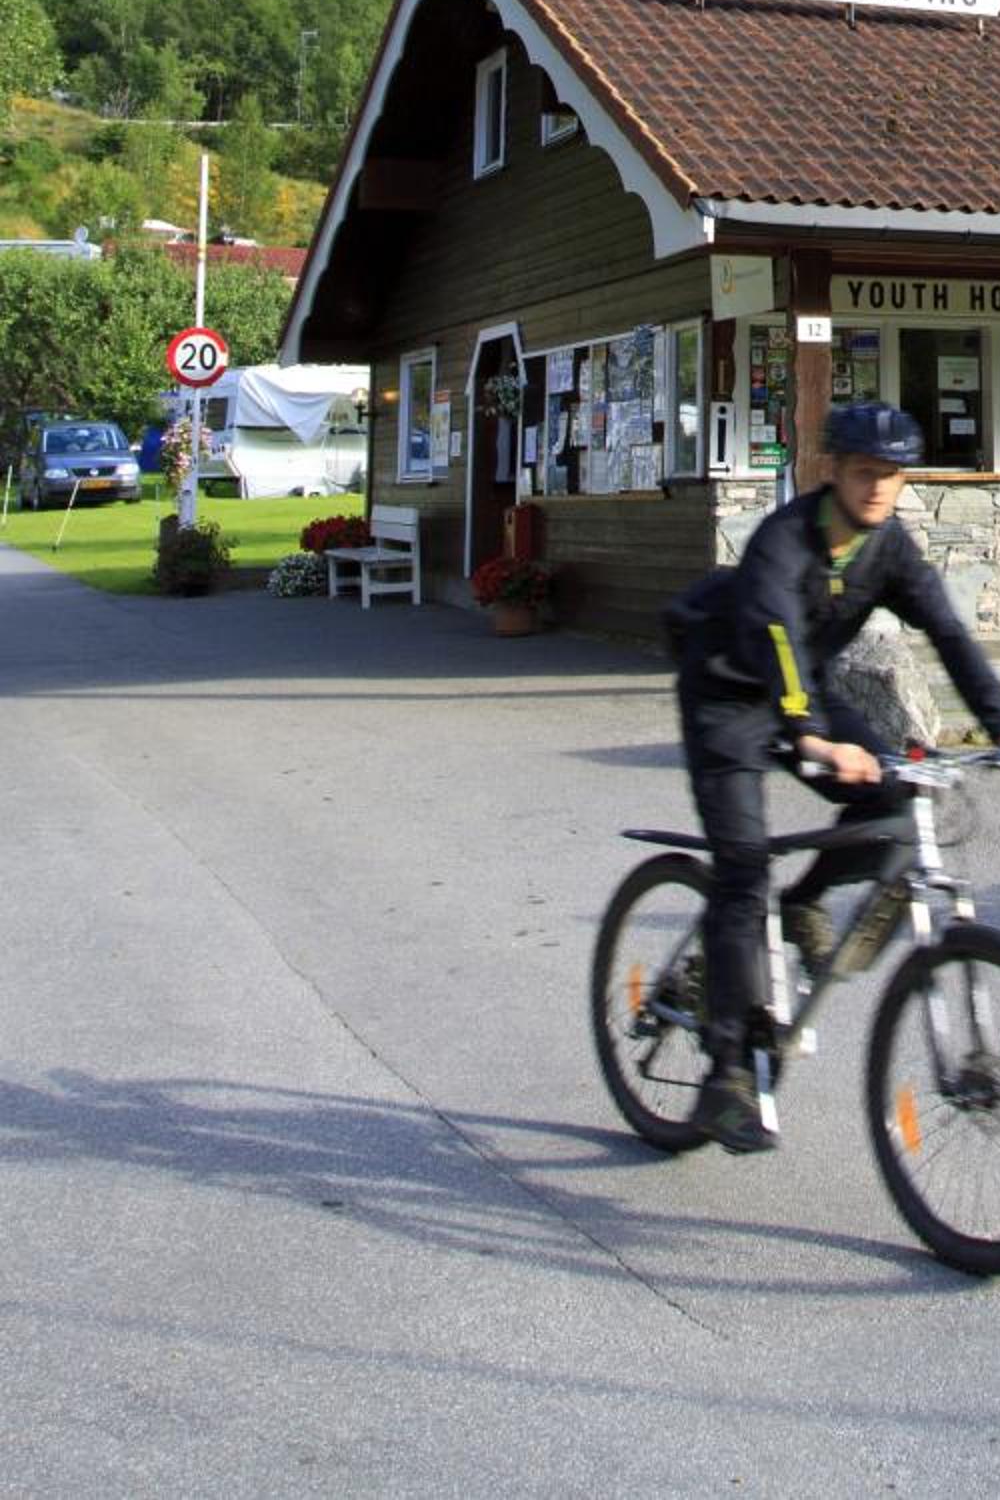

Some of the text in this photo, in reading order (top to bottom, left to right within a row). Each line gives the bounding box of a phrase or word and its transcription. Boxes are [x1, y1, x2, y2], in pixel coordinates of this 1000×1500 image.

[847, 281, 949, 310] YOUTH
[807, 323, 822, 337] 12
[181, 342, 217, 371] 20
